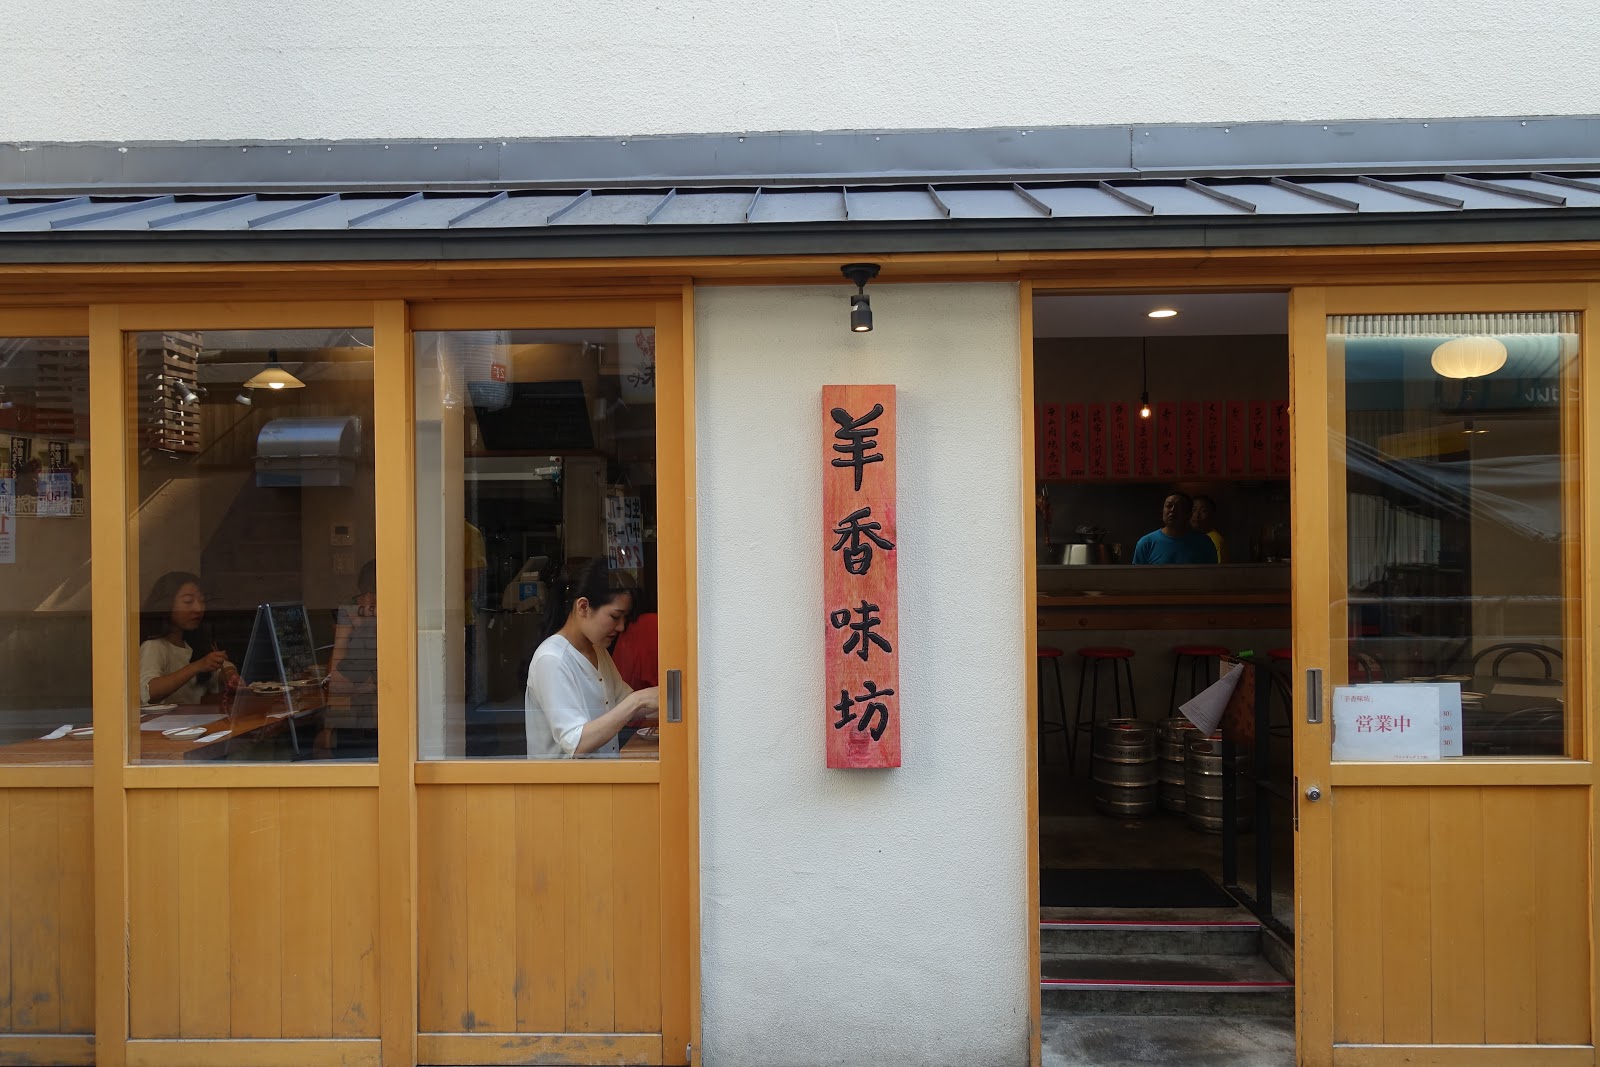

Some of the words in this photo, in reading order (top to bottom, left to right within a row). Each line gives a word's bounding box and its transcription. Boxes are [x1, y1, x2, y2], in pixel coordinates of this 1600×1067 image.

[830, 403, 895, 742] 羊香味坊
[1355, 714, 1411, 733] 営業中
